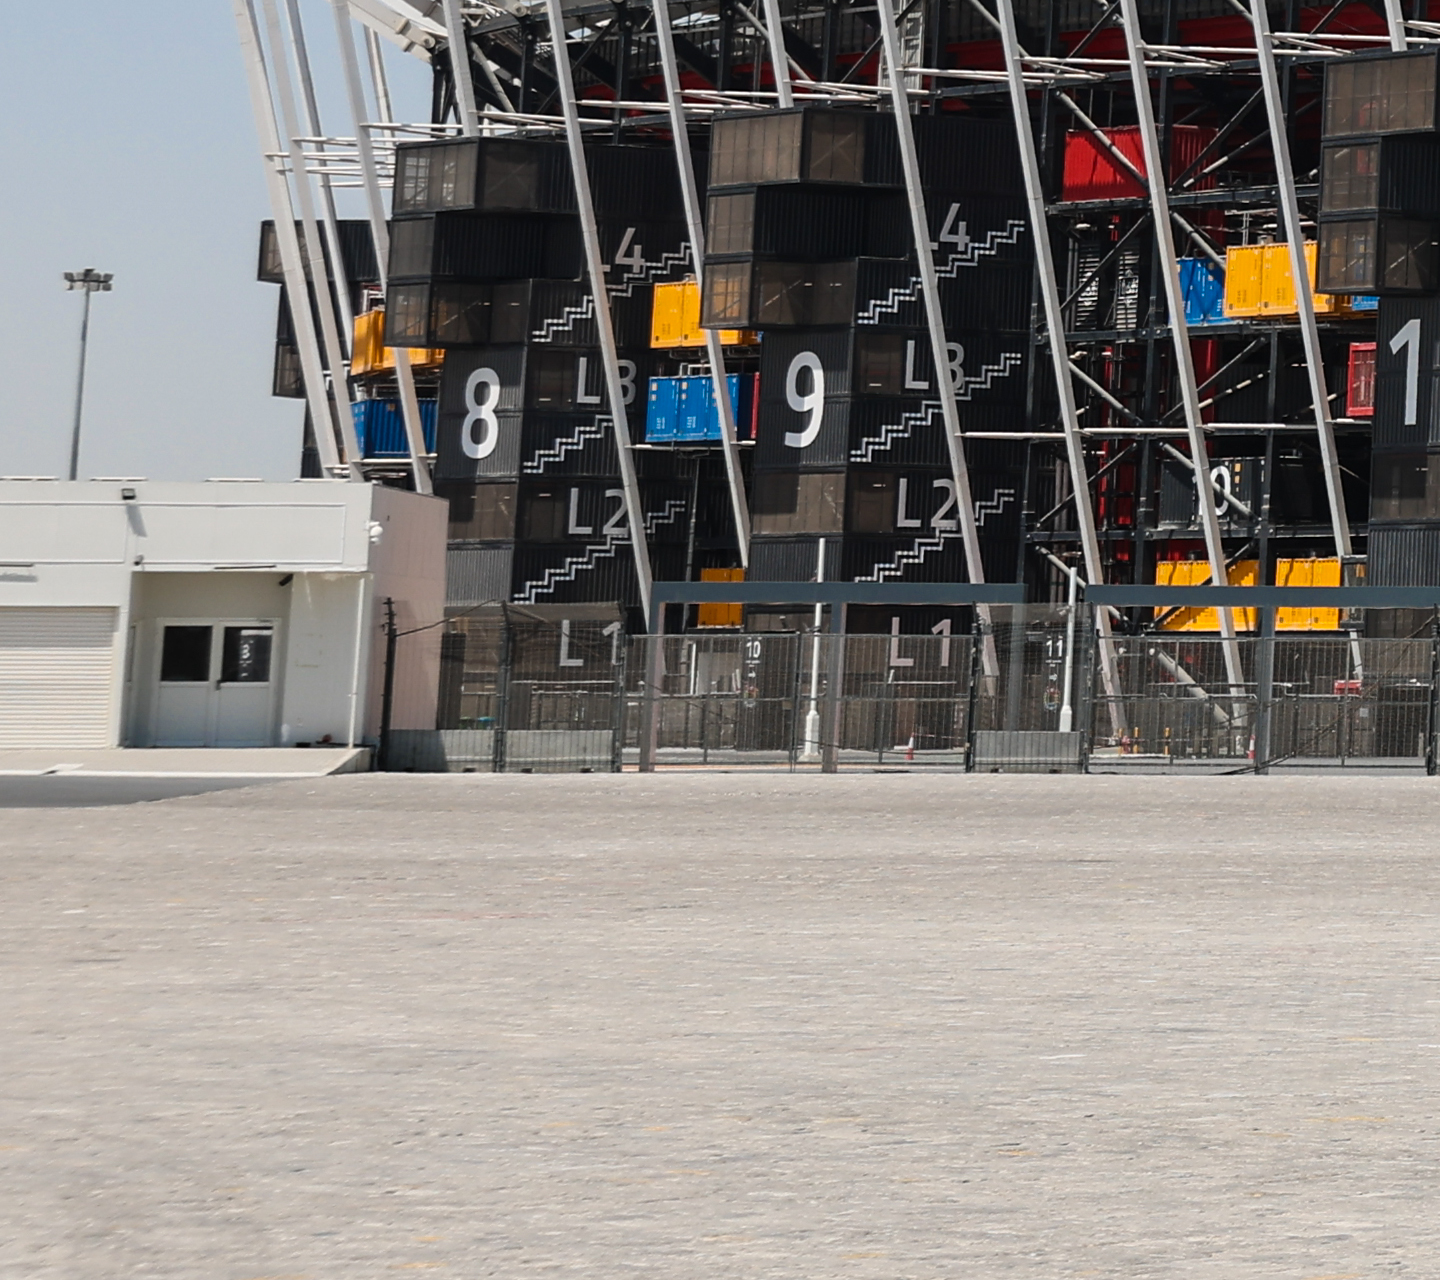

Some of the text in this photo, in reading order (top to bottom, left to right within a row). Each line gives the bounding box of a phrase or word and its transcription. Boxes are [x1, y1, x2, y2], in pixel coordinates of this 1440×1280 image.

[461, 367, 500, 460] 8
[784, 350, 825, 448] 9
[568, 487, 630, 535] L2
[897, 477, 958, 528] L2
[559, 619, 622, 667] L1
[889, 616, 952, 667] L1
